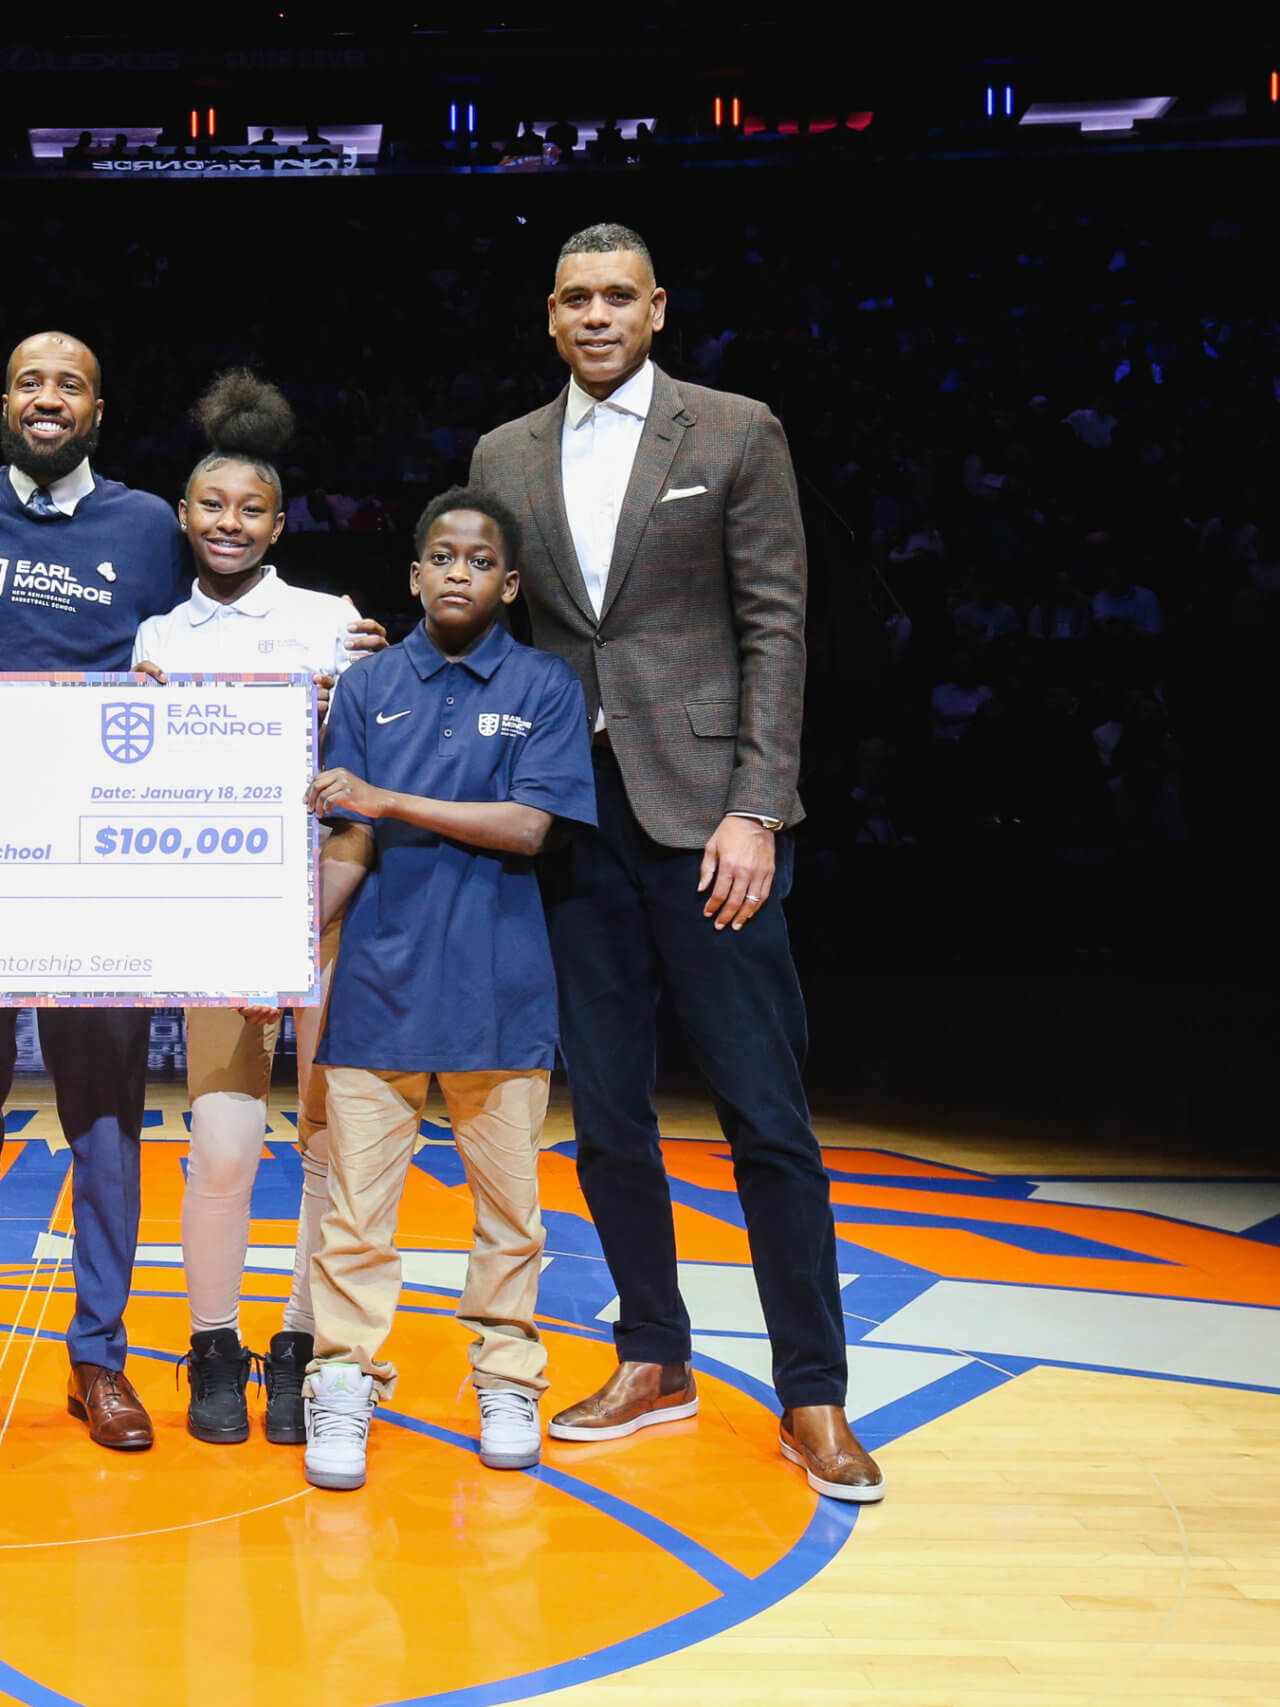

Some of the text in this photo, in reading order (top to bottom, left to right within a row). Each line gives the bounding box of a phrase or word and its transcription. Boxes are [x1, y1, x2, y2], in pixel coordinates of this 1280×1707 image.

[16, 560, 78, 582] EARL
[13, 574, 112, 605] MONROE
[167, 704, 238, 718] EARL
[167, 721, 282, 736] MONROE
[90, 786, 282, 803] Date: January 18, 2023
[94, 826, 269, 859] $100,000
[89, 954, 153, 972] Series
